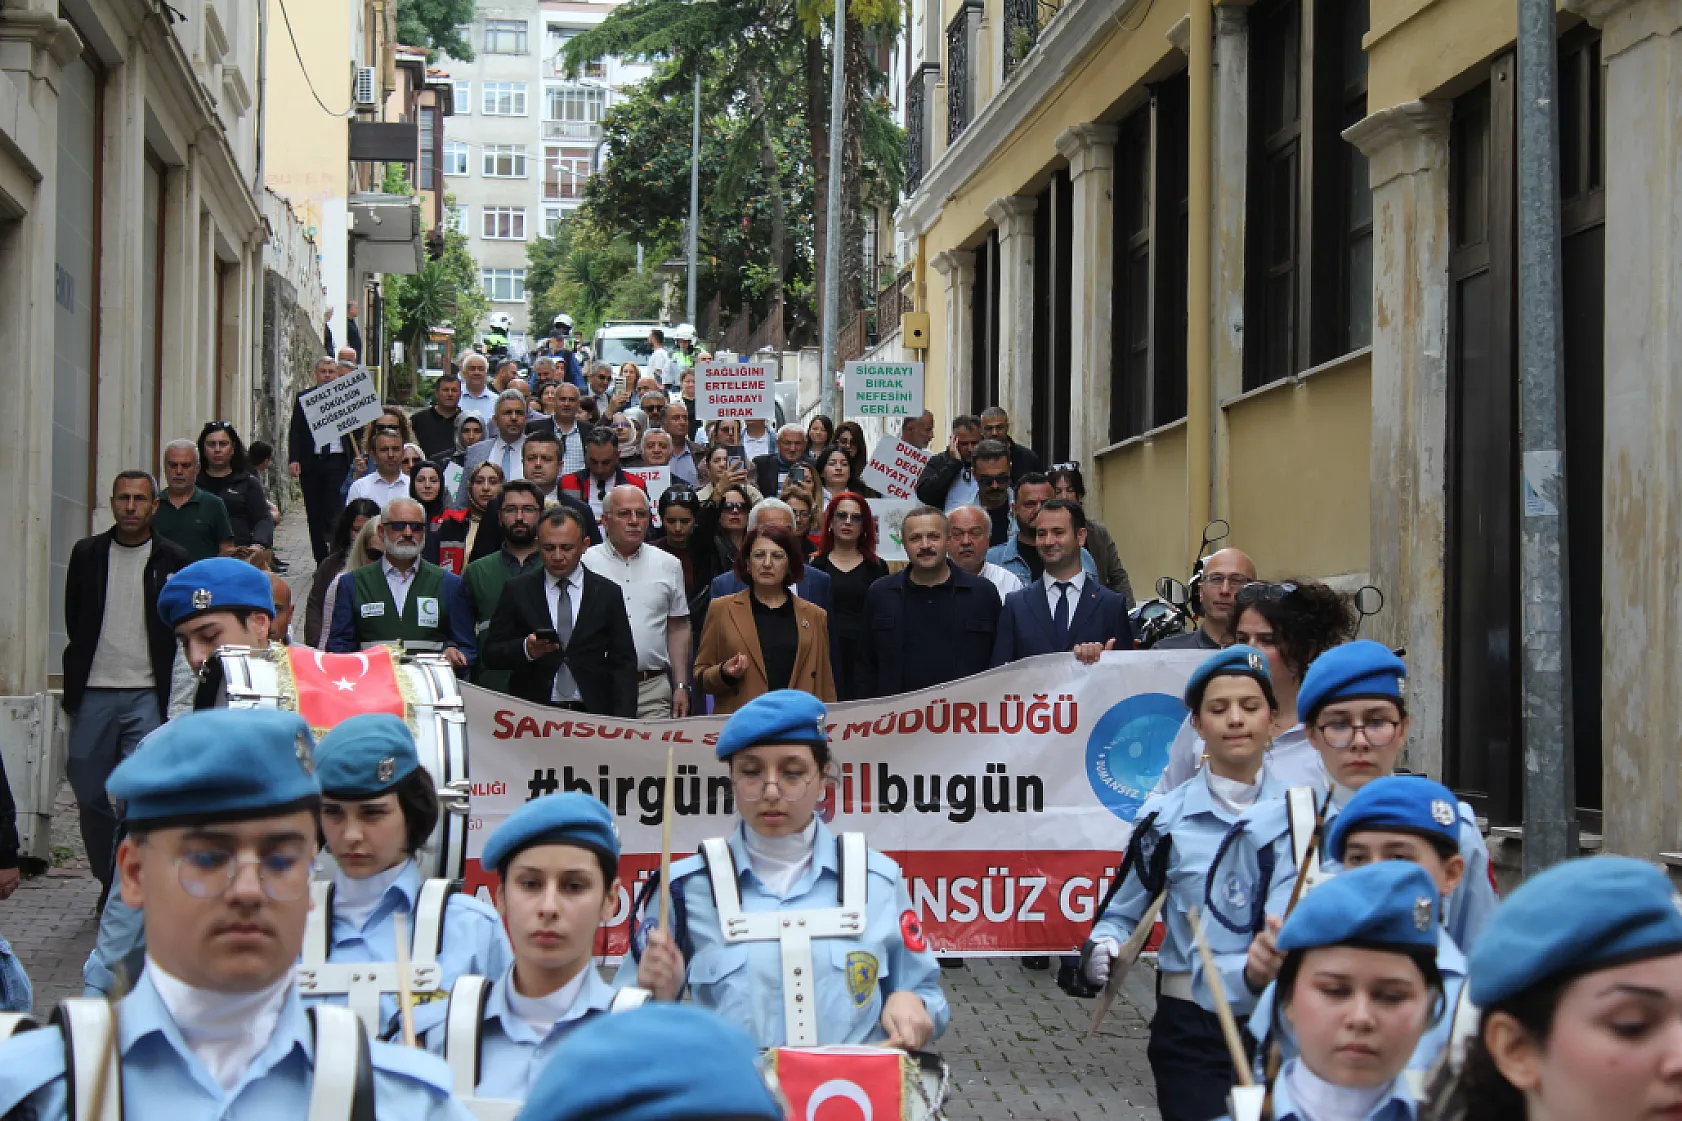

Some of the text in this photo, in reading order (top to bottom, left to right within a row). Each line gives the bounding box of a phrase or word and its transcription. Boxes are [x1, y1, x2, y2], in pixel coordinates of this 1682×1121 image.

[856, 364, 912, 376] SİGARAYI
[705, 380, 765, 391] ERTELEME
[865, 379, 902, 388] BIRAK
[708, 394, 763, 404] SİGARAYI
[856, 390, 912, 402] NEFESİNİ
[717, 408, 753, 417] BIRAK
[861, 403, 908, 414] GERİ AL
[896, 443, 928, 464] DUMA
[869, 459, 909, 485] HAYATI
[895, 457, 922, 476] DEĞİ
[493, 710, 652, 740] SAMSUN
[842, 694, 1078, 741] MÜDÜRLÜĞÜ
[470, 780, 506, 796] NLIĞI
